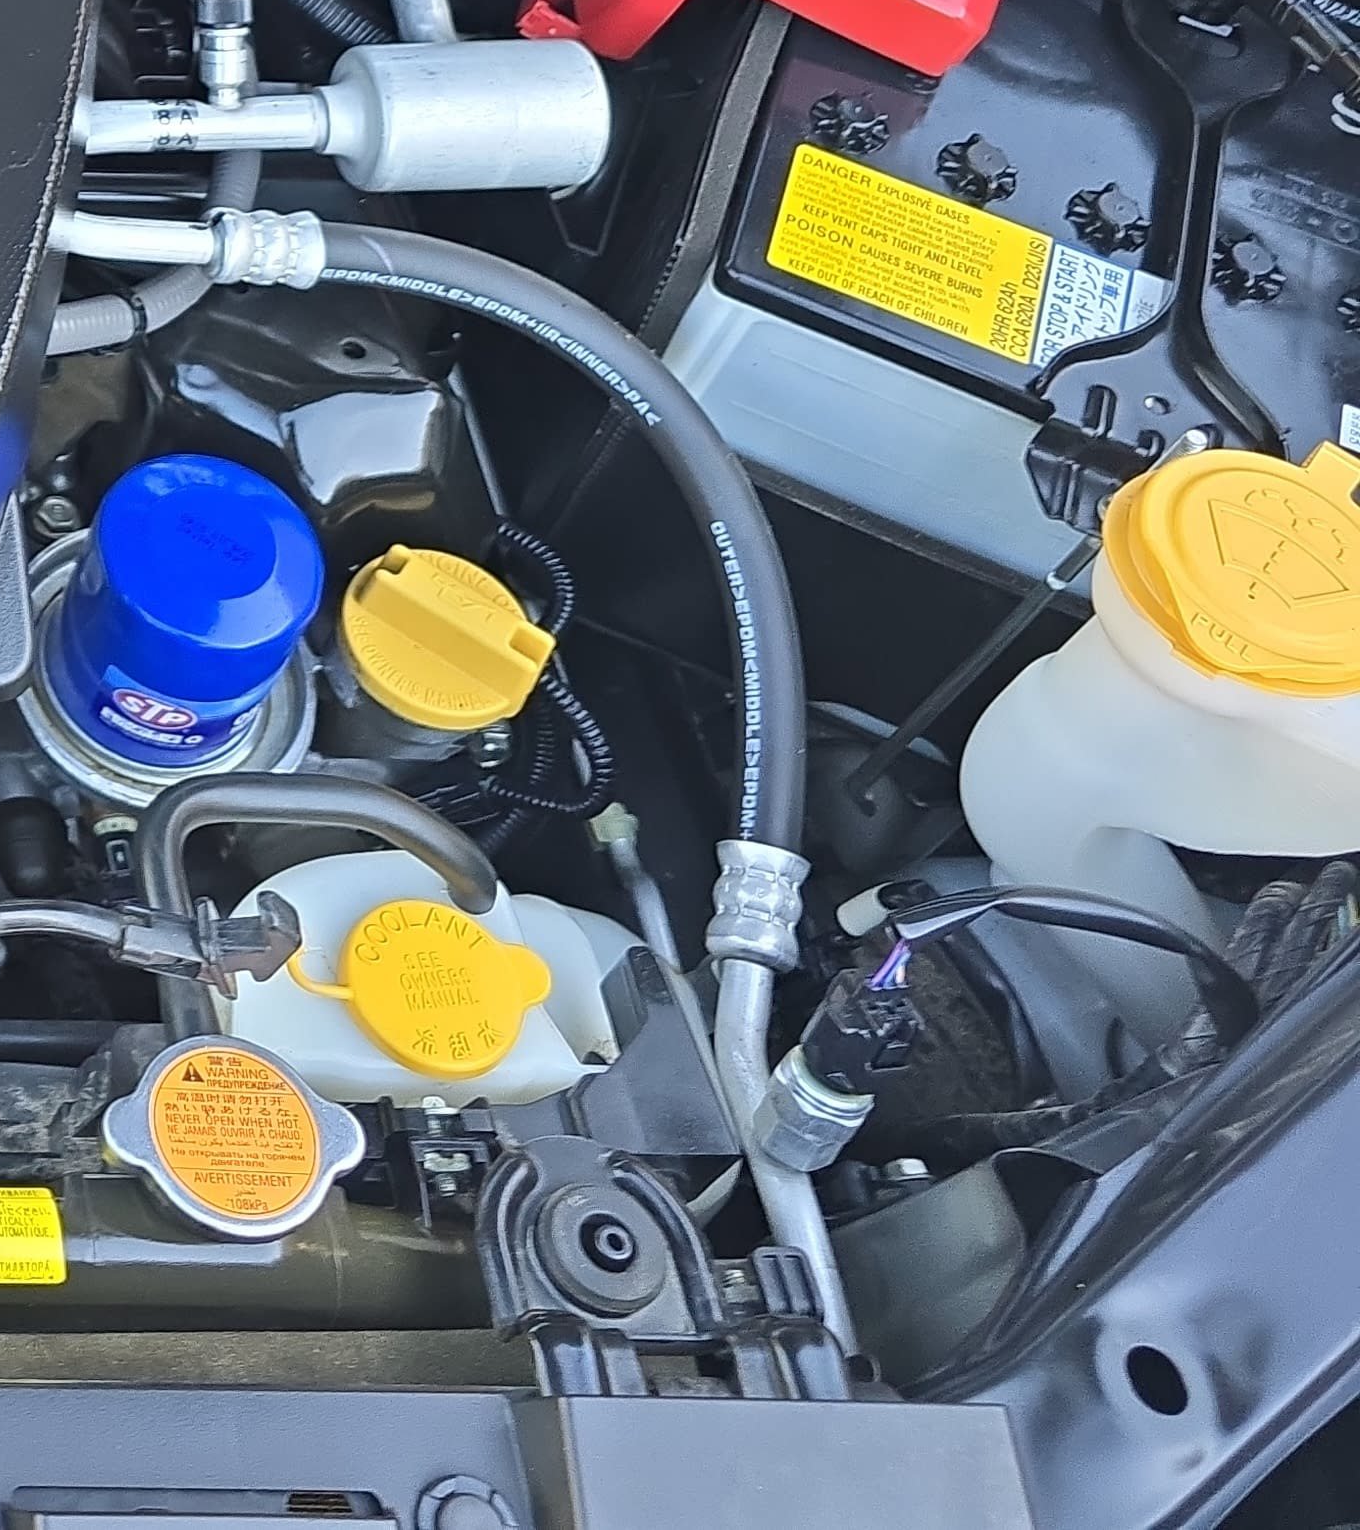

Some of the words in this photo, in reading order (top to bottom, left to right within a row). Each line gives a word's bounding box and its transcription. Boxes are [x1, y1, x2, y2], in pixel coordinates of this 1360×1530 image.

[801, 152, 871, 188] DANGER
[876, 181, 931, 210] EXPLOSIVE
[935, 204, 970, 225] GASES
[785, 213, 854, 249] POISON
[859, 243, 900, 267] CAUSES
[903, 259, 944, 284] SEVERE
[946, 276, 983, 299] BURNS
[802, 202, 829, 220] KEEP
[830, 213, 857, 231] VENT
[860, 224, 888, 243] CAPS
[890, 236, 922, 256] TIGHT
[924, 248, 948, 266] AND
[950, 258, 984, 280] LEVEL
[1021, 234, 1048, 291] D23(JIS)
[1055, 248, 1081, 293] START
[787, 257, 814, 275] KEEP
[816, 268, 839, 285] OUT
[841, 277, 856, 291] OF
[857, 284, 894, 306] REACH
[899, 300, 911, 313] OF
[913, 305, 968, 336] CHILDREN
[996, 278, 1018, 316] 62Ah
[1014, 291, 1036, 329] 620A
[1053, 292, 1071, 305] &
[1070, 258, 1101, 340] アイドリング
[1093, 267, 1125, 340] トップ車用
[989, 313, 1010, 351] 20HR
[1008, 324, 1030, 359] CCA
[1046, 305, 1070, 341] STOP
[120, 694, 193, 725] STP
[354, 906, 489, 963] COOLANT
[404, 986, 481, 1012] MANUAL
[205, 1067, 270, 1080] WARNING
[165, 1113, 200, 1124] NEVER
[205, 1114, 234, 1126] OPEN
[238, 1116, 272, 1128] WHEN
[167, 1123, 179, 1134] NE
[182, 1124, 216, 1136] JAMAIS
[220, 1126, 255, 1138] OUVRIR
[193, 1170, 294, 1189] AVERTISSEMENT
